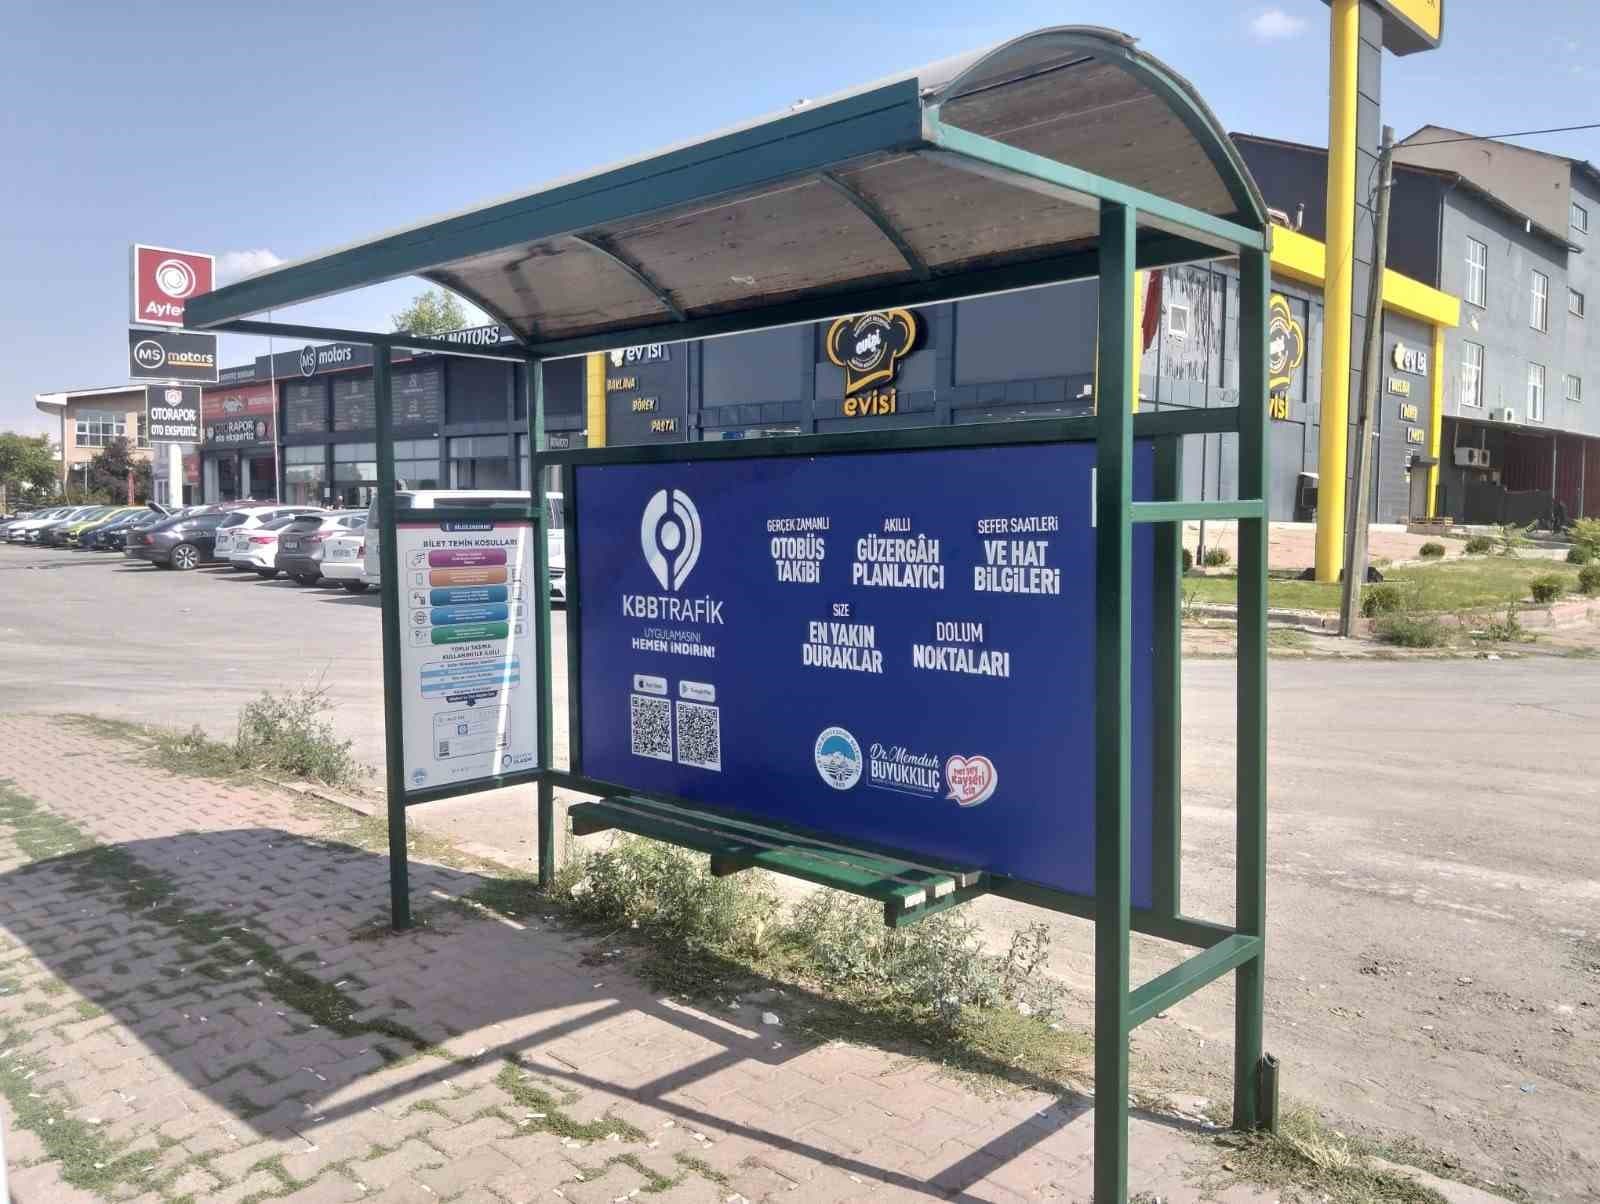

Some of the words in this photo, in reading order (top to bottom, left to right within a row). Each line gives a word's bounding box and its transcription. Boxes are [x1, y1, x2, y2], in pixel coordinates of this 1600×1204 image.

[146, 301, 184, 316] Ayte
[138, 348, 161, 361] MS
[168, 351, 214, 364] motors
[300, 354, 315, 367] MS
[318, 346, 352, 364] motors
[151, 425, 164, 437] OTO
[650, 418, 675, 432] PASTA
[767, 518, 796, 532] GERÇEK
[797, 516, 830, 531] ZAMANLI
[883, 517, 911, 532] AKILLI
[977, 518, 1008, 534] SEFER
[423, 539, 446, 548] BİLET
[771, 533, 825, 561] OTOBÜS
[856, 533, 940, 564] GÜZERGÂH
[983, 540, 1008, 566] VE
[1011, 540, 1049, 567] HAT
[852, 562, 945, 590] PLANLAYICI
[622, 594, 725, 625] KBBTRAFİK
[644, 628, 702, 643] UYGULAMASINI
[809, 621, 828, 644] EN
[831, 622, 875, 649] YAKIN
[935, 621, 983, 643] DOLUM
[632, 637, 668, 653] HEMEN
[802, 643, 883, 674] DURAKLAR
[912, 644, 1010, 678] NOKTALARI
[870, 742, 888, 760] Dr.
[889, 746, 940, 769] Memduh
